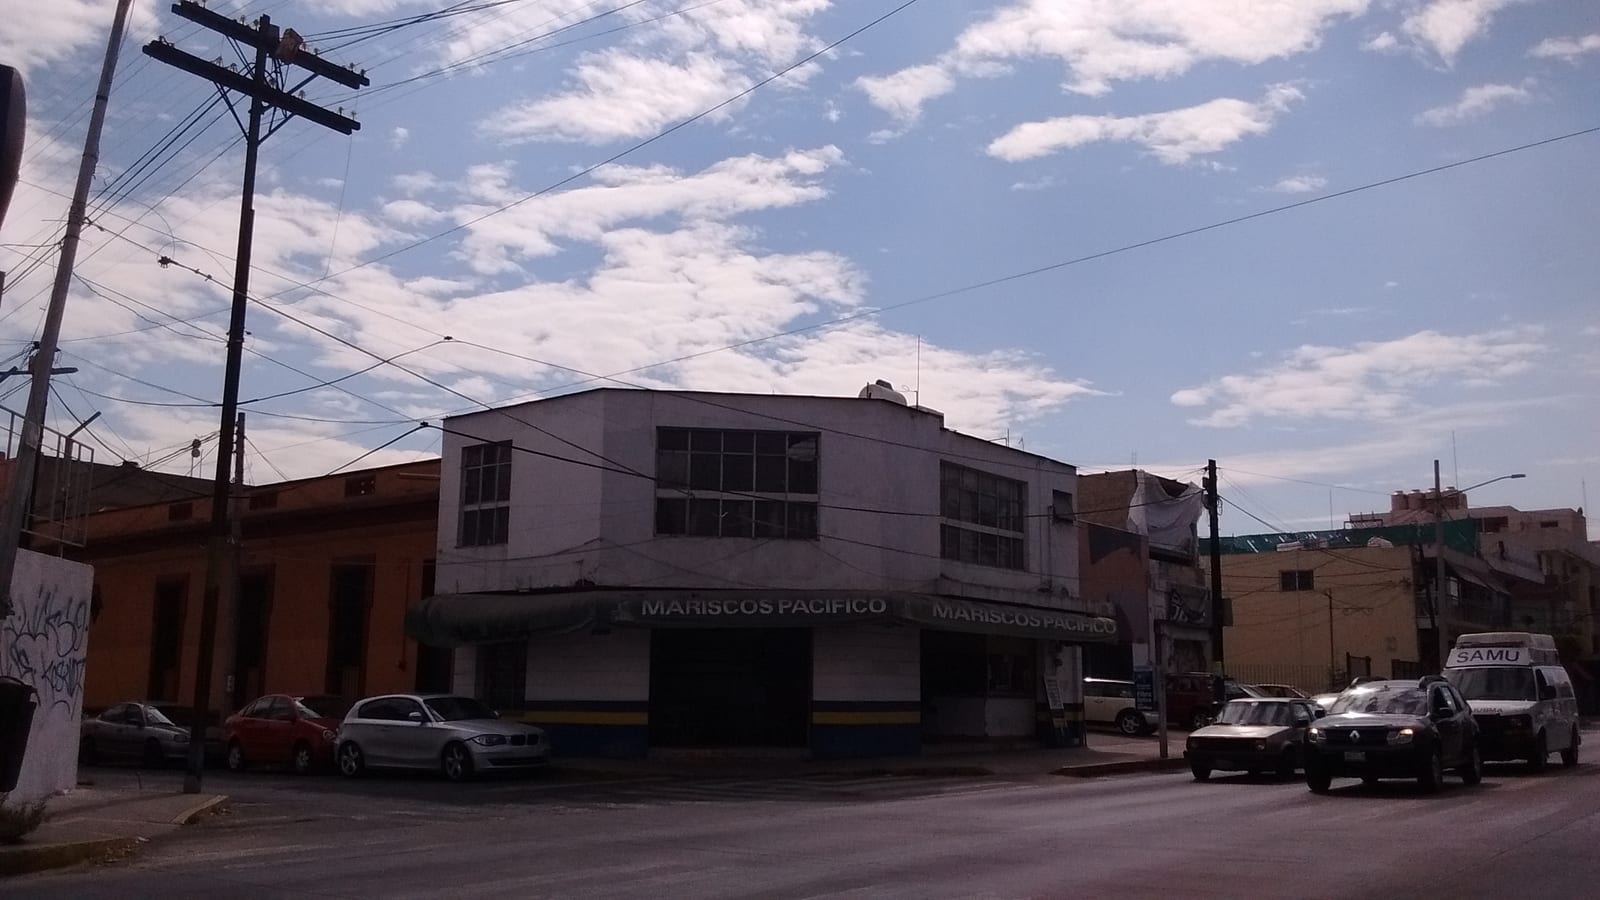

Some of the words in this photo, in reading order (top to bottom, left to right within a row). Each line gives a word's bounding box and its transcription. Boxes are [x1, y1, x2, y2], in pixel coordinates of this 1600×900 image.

[642, 599, 774, 615] MARISCOS
[778, 599, 887, 615] PACIFICO
[933, 604, 1041, 627] MARISCOS
[1043, 617, 1117, 634] PACIFICO
[1457, 649, 1520, 663] SAMU
